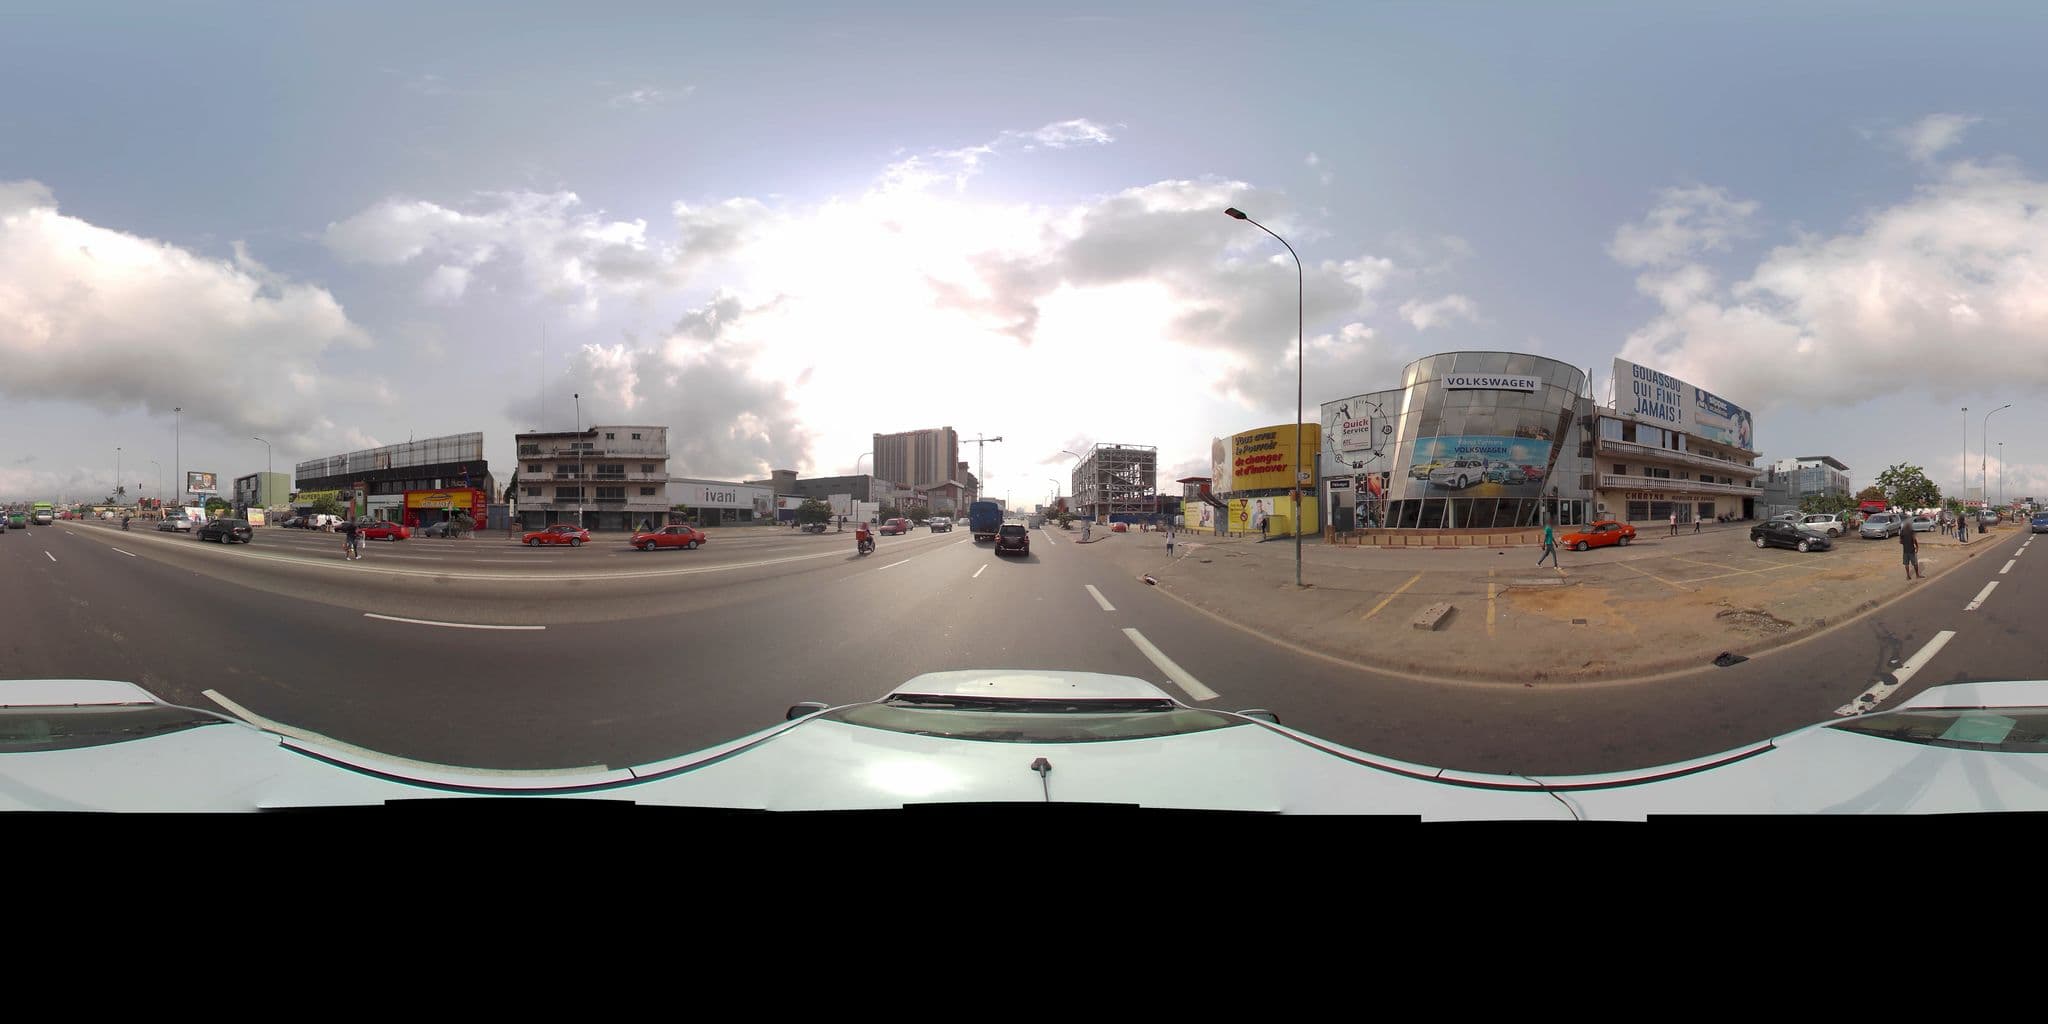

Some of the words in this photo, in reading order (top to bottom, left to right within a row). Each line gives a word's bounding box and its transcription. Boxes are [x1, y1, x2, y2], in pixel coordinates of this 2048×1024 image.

[1447, 377, 1535, 388] VOLKSWAGEN
[1632, 364, 1681, 393] GOUASSOU
[1633, 380, 1652, 398] QUI
[1656, 387, 1681, 407] FINIT
[1633, 396, 1675, 422] JAMAIS
[1343, 419, 1369, 428] Quick
[1343, 426, 1369, 435] Service
[1454, 446, 1507, 454] VOLKSWAGEN
[1245, 453, 1283, 464] changer
[694, 487, 736, 503] ivani
